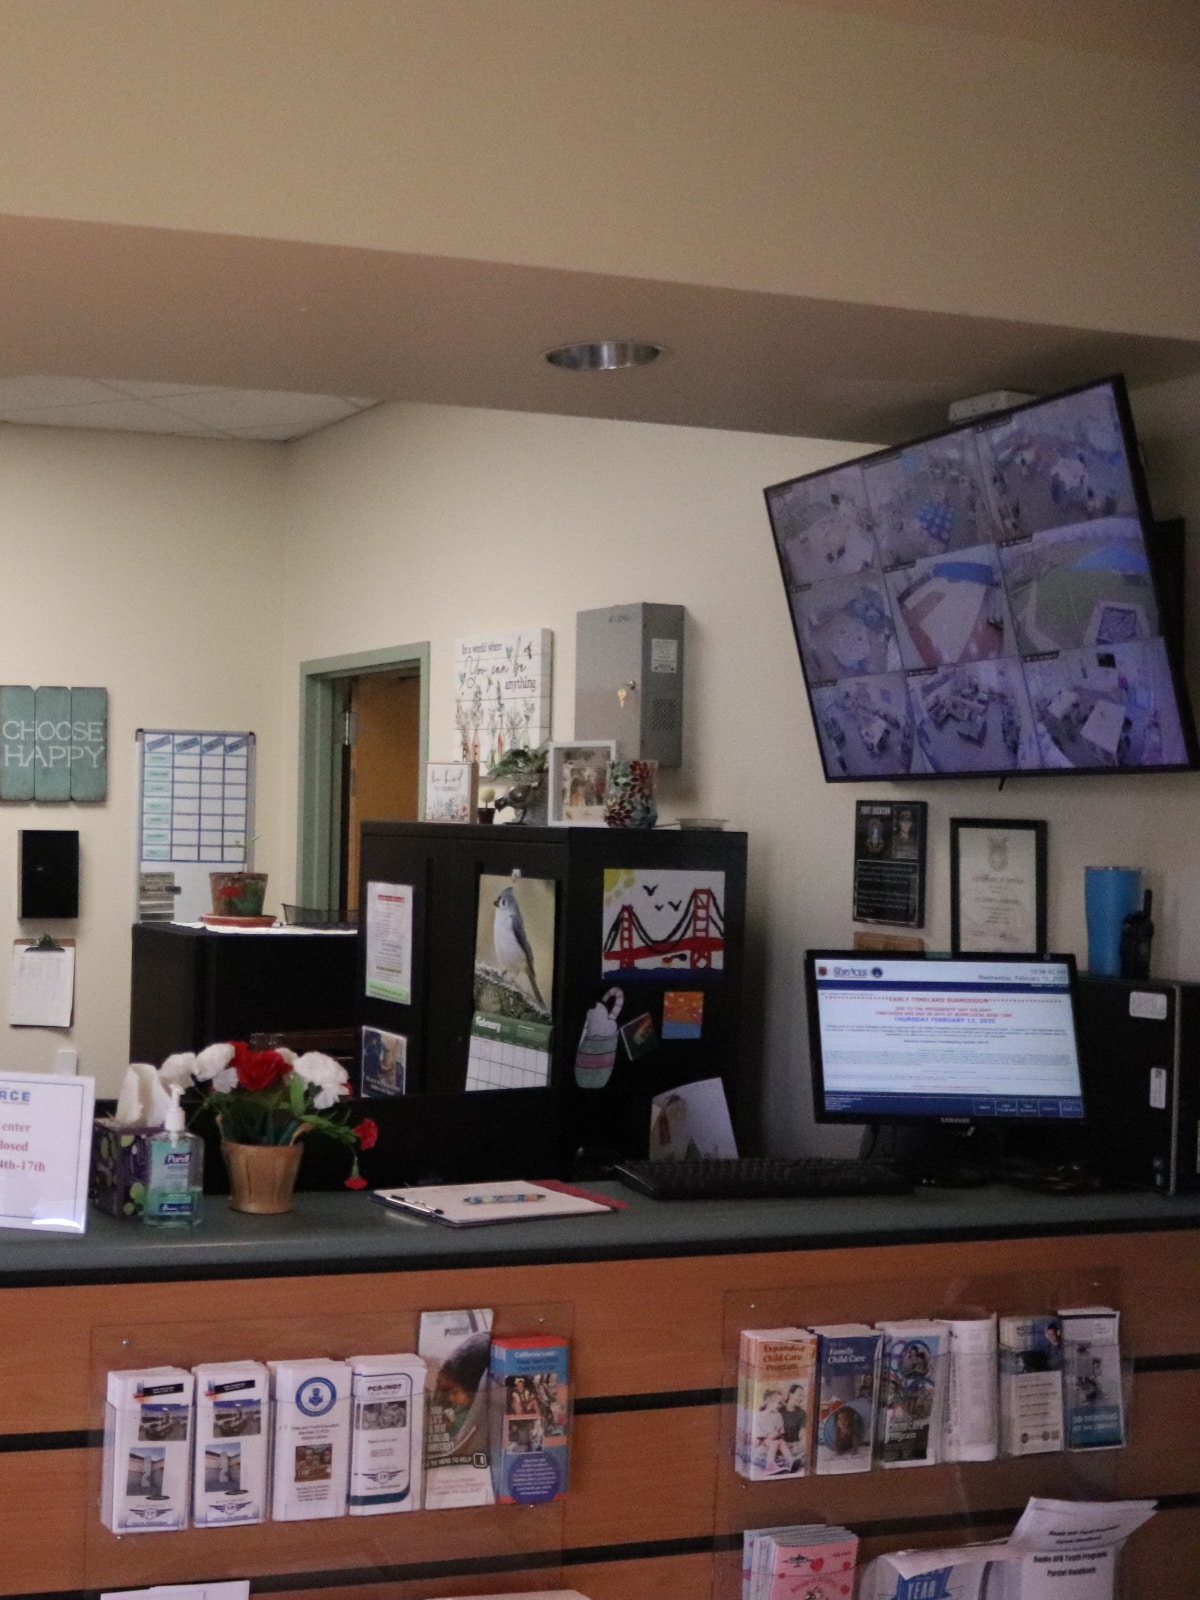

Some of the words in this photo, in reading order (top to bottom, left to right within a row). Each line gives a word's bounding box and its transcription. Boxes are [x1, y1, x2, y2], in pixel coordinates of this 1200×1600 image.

[491, 665, 510, 675] can
[505, 676, 537, 692] anything
[2, 719, 105, 742] CHOOSE
[3, 745, 105, 768] HAPPY
[475, 1016, 502, 1033] February
[764, 1344, 806, 1354] Expanded
[829, 1347, 854, 1357] Family
[763, 1354, 783, 1363] Child
[784, 1353, 804, 1361] Care
[827, 1356, 848, 1365] Child
[849, 1355, 867, 1364] Care
[766, 1364, 798, 1372] Program
[1033, 1555, 1051, 1563] Beale
[1065, 1554, 1081, 1562] Youth
[1082, 1551, 1107, 1560] Programs
[1047, 1569, 1067, 1577] Parent
[1068, 1566, 1096, 1576] Handbook
[907, 1580, 936, 1599] YEAR
